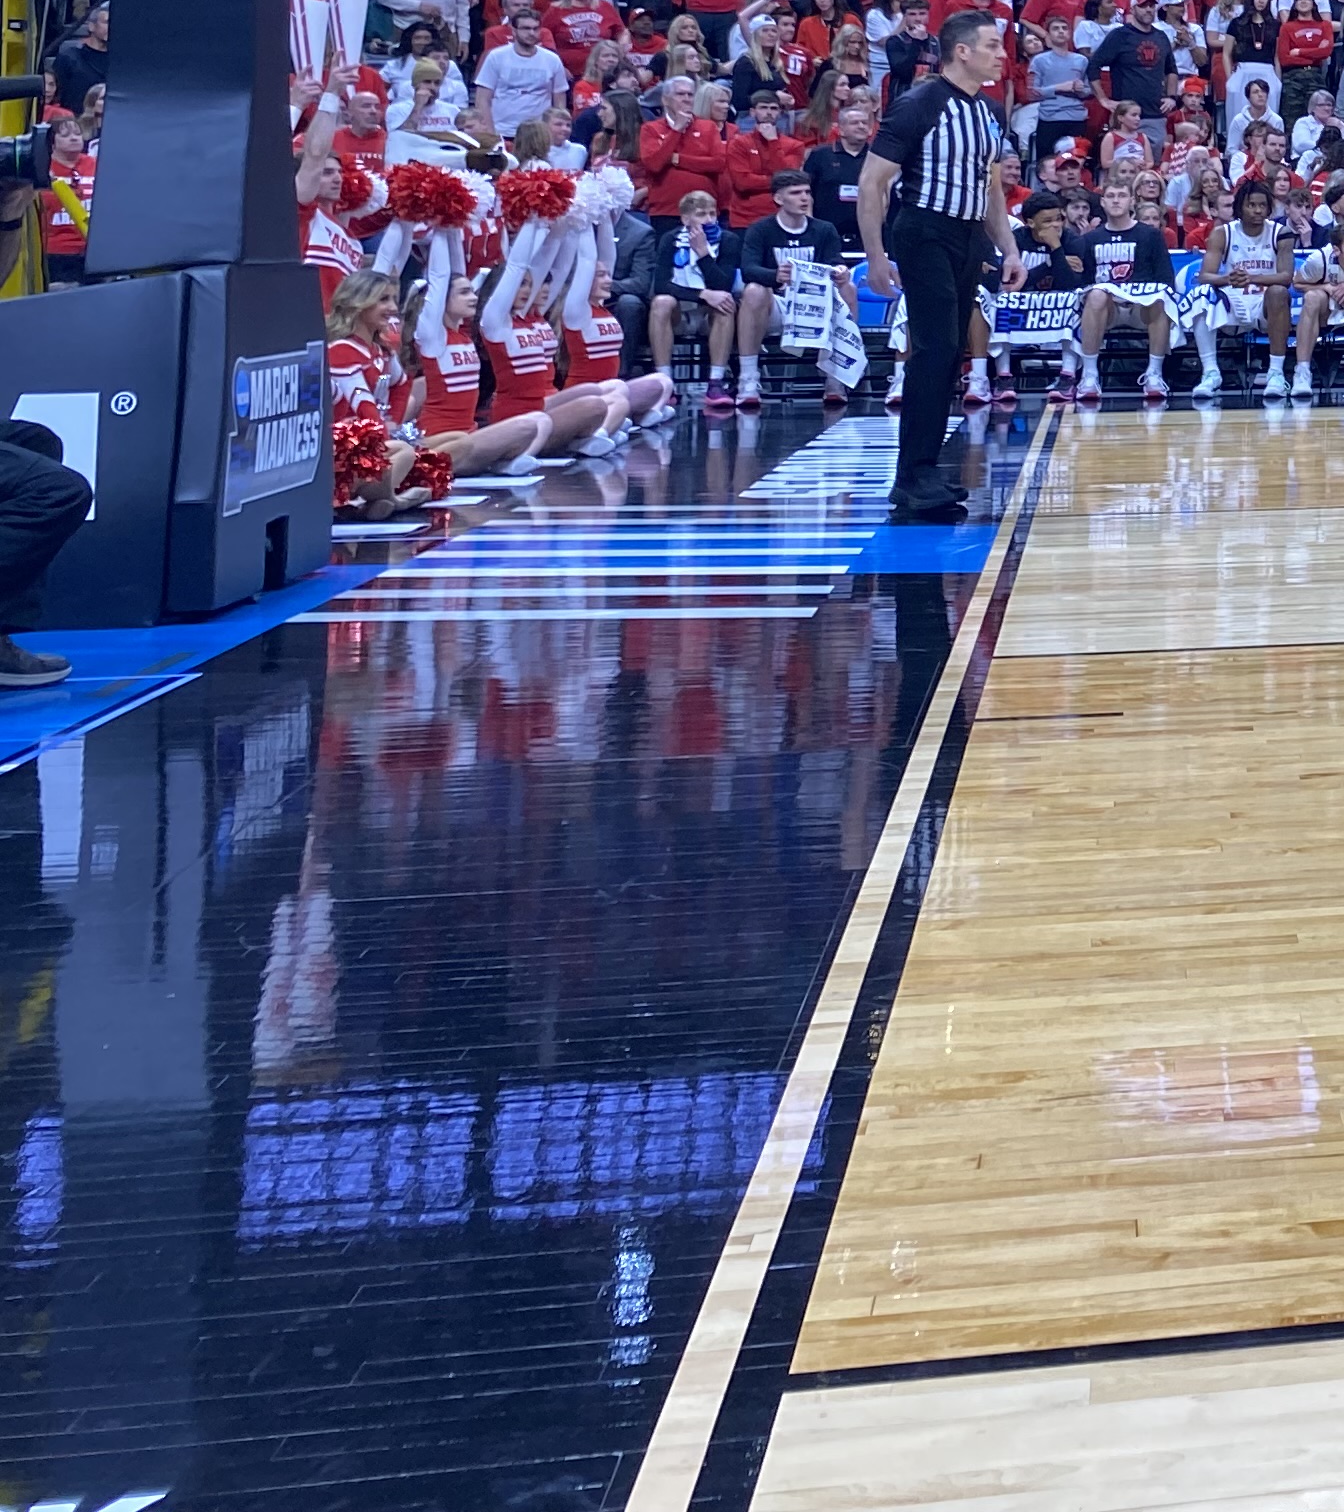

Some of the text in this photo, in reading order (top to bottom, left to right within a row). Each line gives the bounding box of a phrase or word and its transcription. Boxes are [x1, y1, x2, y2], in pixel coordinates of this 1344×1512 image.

[1095, 241, 1137, 264] DOUBT
[250, 363, 299, 421] MARCH
[254, 410, 321, 474] MADNESS
